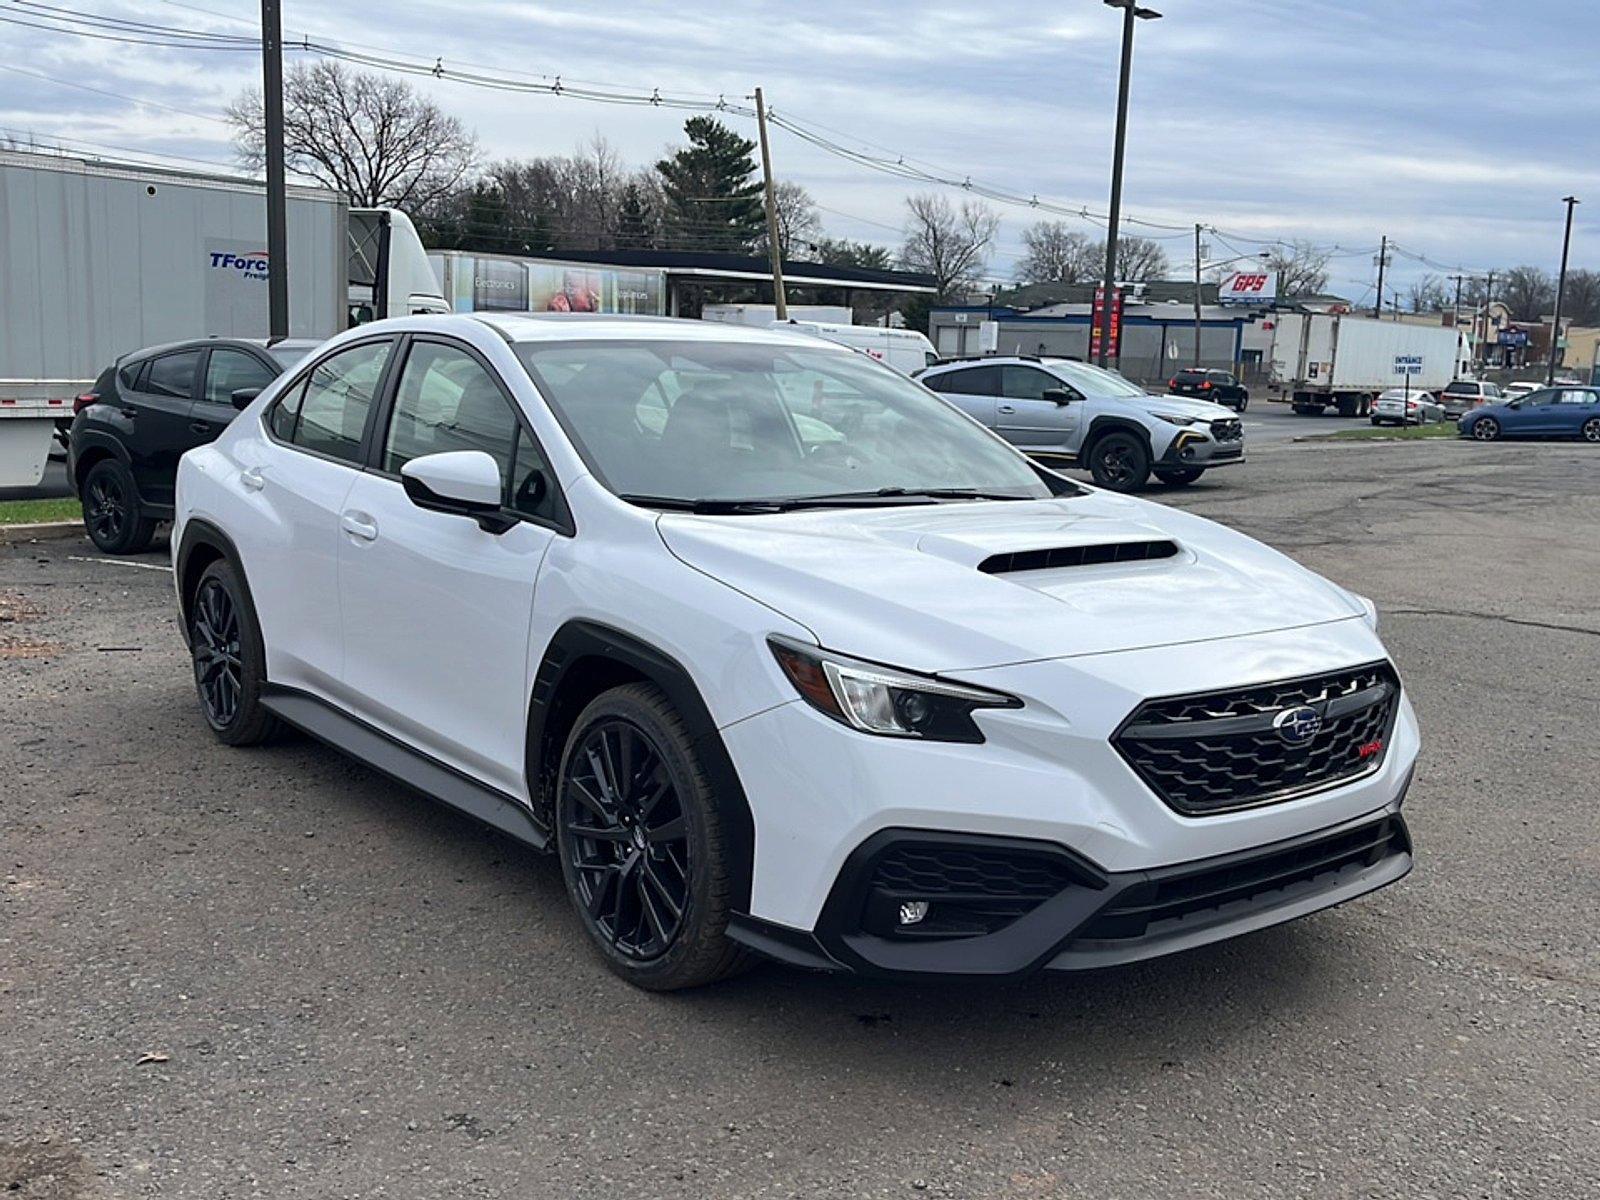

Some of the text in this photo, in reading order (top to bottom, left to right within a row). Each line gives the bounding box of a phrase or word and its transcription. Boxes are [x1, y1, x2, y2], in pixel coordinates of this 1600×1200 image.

[210, 252, 269, 271] TForc
[1231, 274, 1268, 291] GPS
[1394, 356, 1422, 364] ENTRANCE
